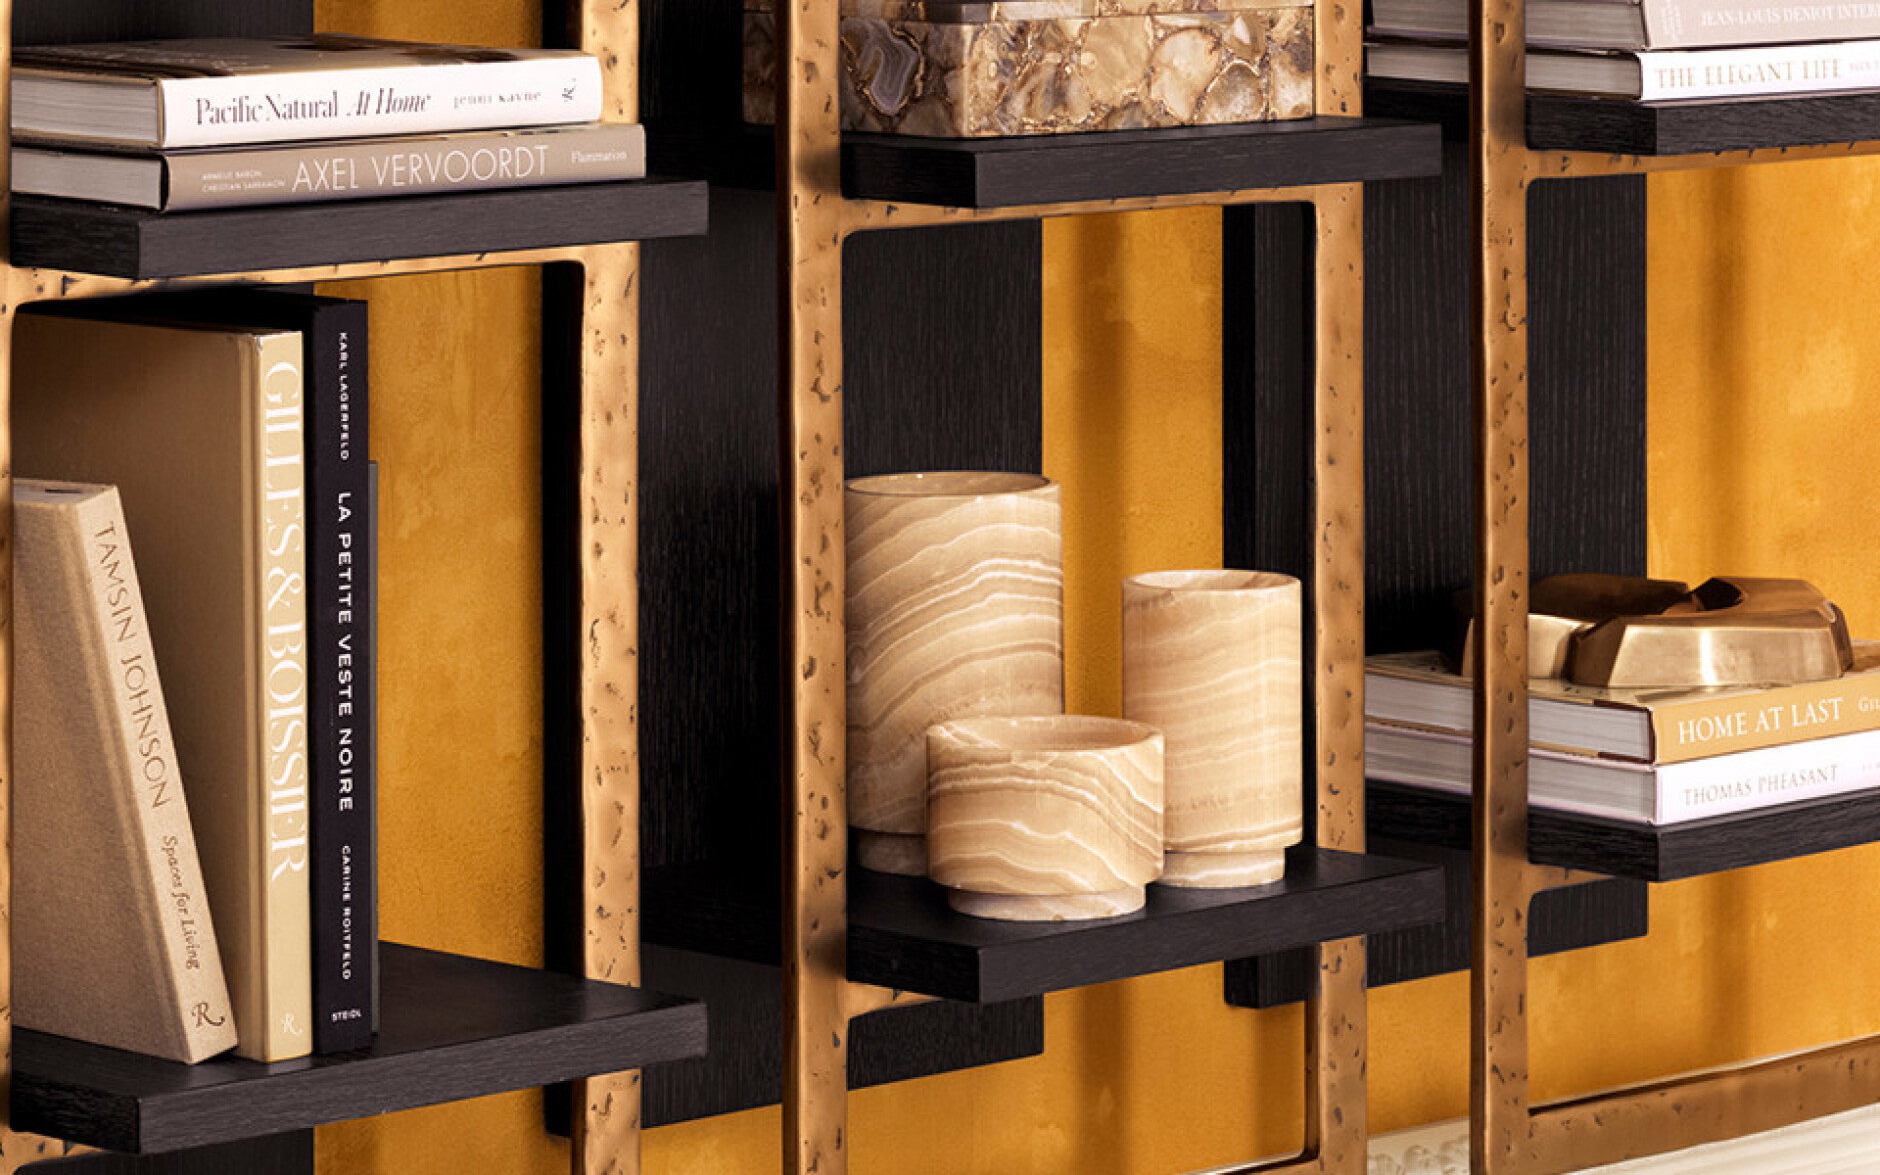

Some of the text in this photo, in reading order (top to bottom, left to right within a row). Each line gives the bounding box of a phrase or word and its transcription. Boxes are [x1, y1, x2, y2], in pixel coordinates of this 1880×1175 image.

[1655, 67, 1695, 88] THE
[1705, 62, 1794, 86] ELEGANT
[1803, 58, 1841, 80] LIFE
[196, 87, 431, 125] Pacific Natural At Home
[292, 145, 549, 192] AXEL VERVOORDT
[338, 332, 350, 461] KARL LAGERFELD
[265, 361, 306, 883] GILLES & BOISSIER
[94, 521, 172, 809] TAMSIN JOHNSON
[338, 492, 353, 812] LA PETITE VESTE NOIRE
[1678, 697, 1844, 745] HOME AT LAST
[1683, 764, 1839, 807] THOMAS PHEASANT
[161, 835, 201, 970] Spaces for Living
[342, 845, 351, 980] CARINE ROITFELD
[192, 1000, 226, 1027] R
[331, 1008, 363, 1023] STEIDL
